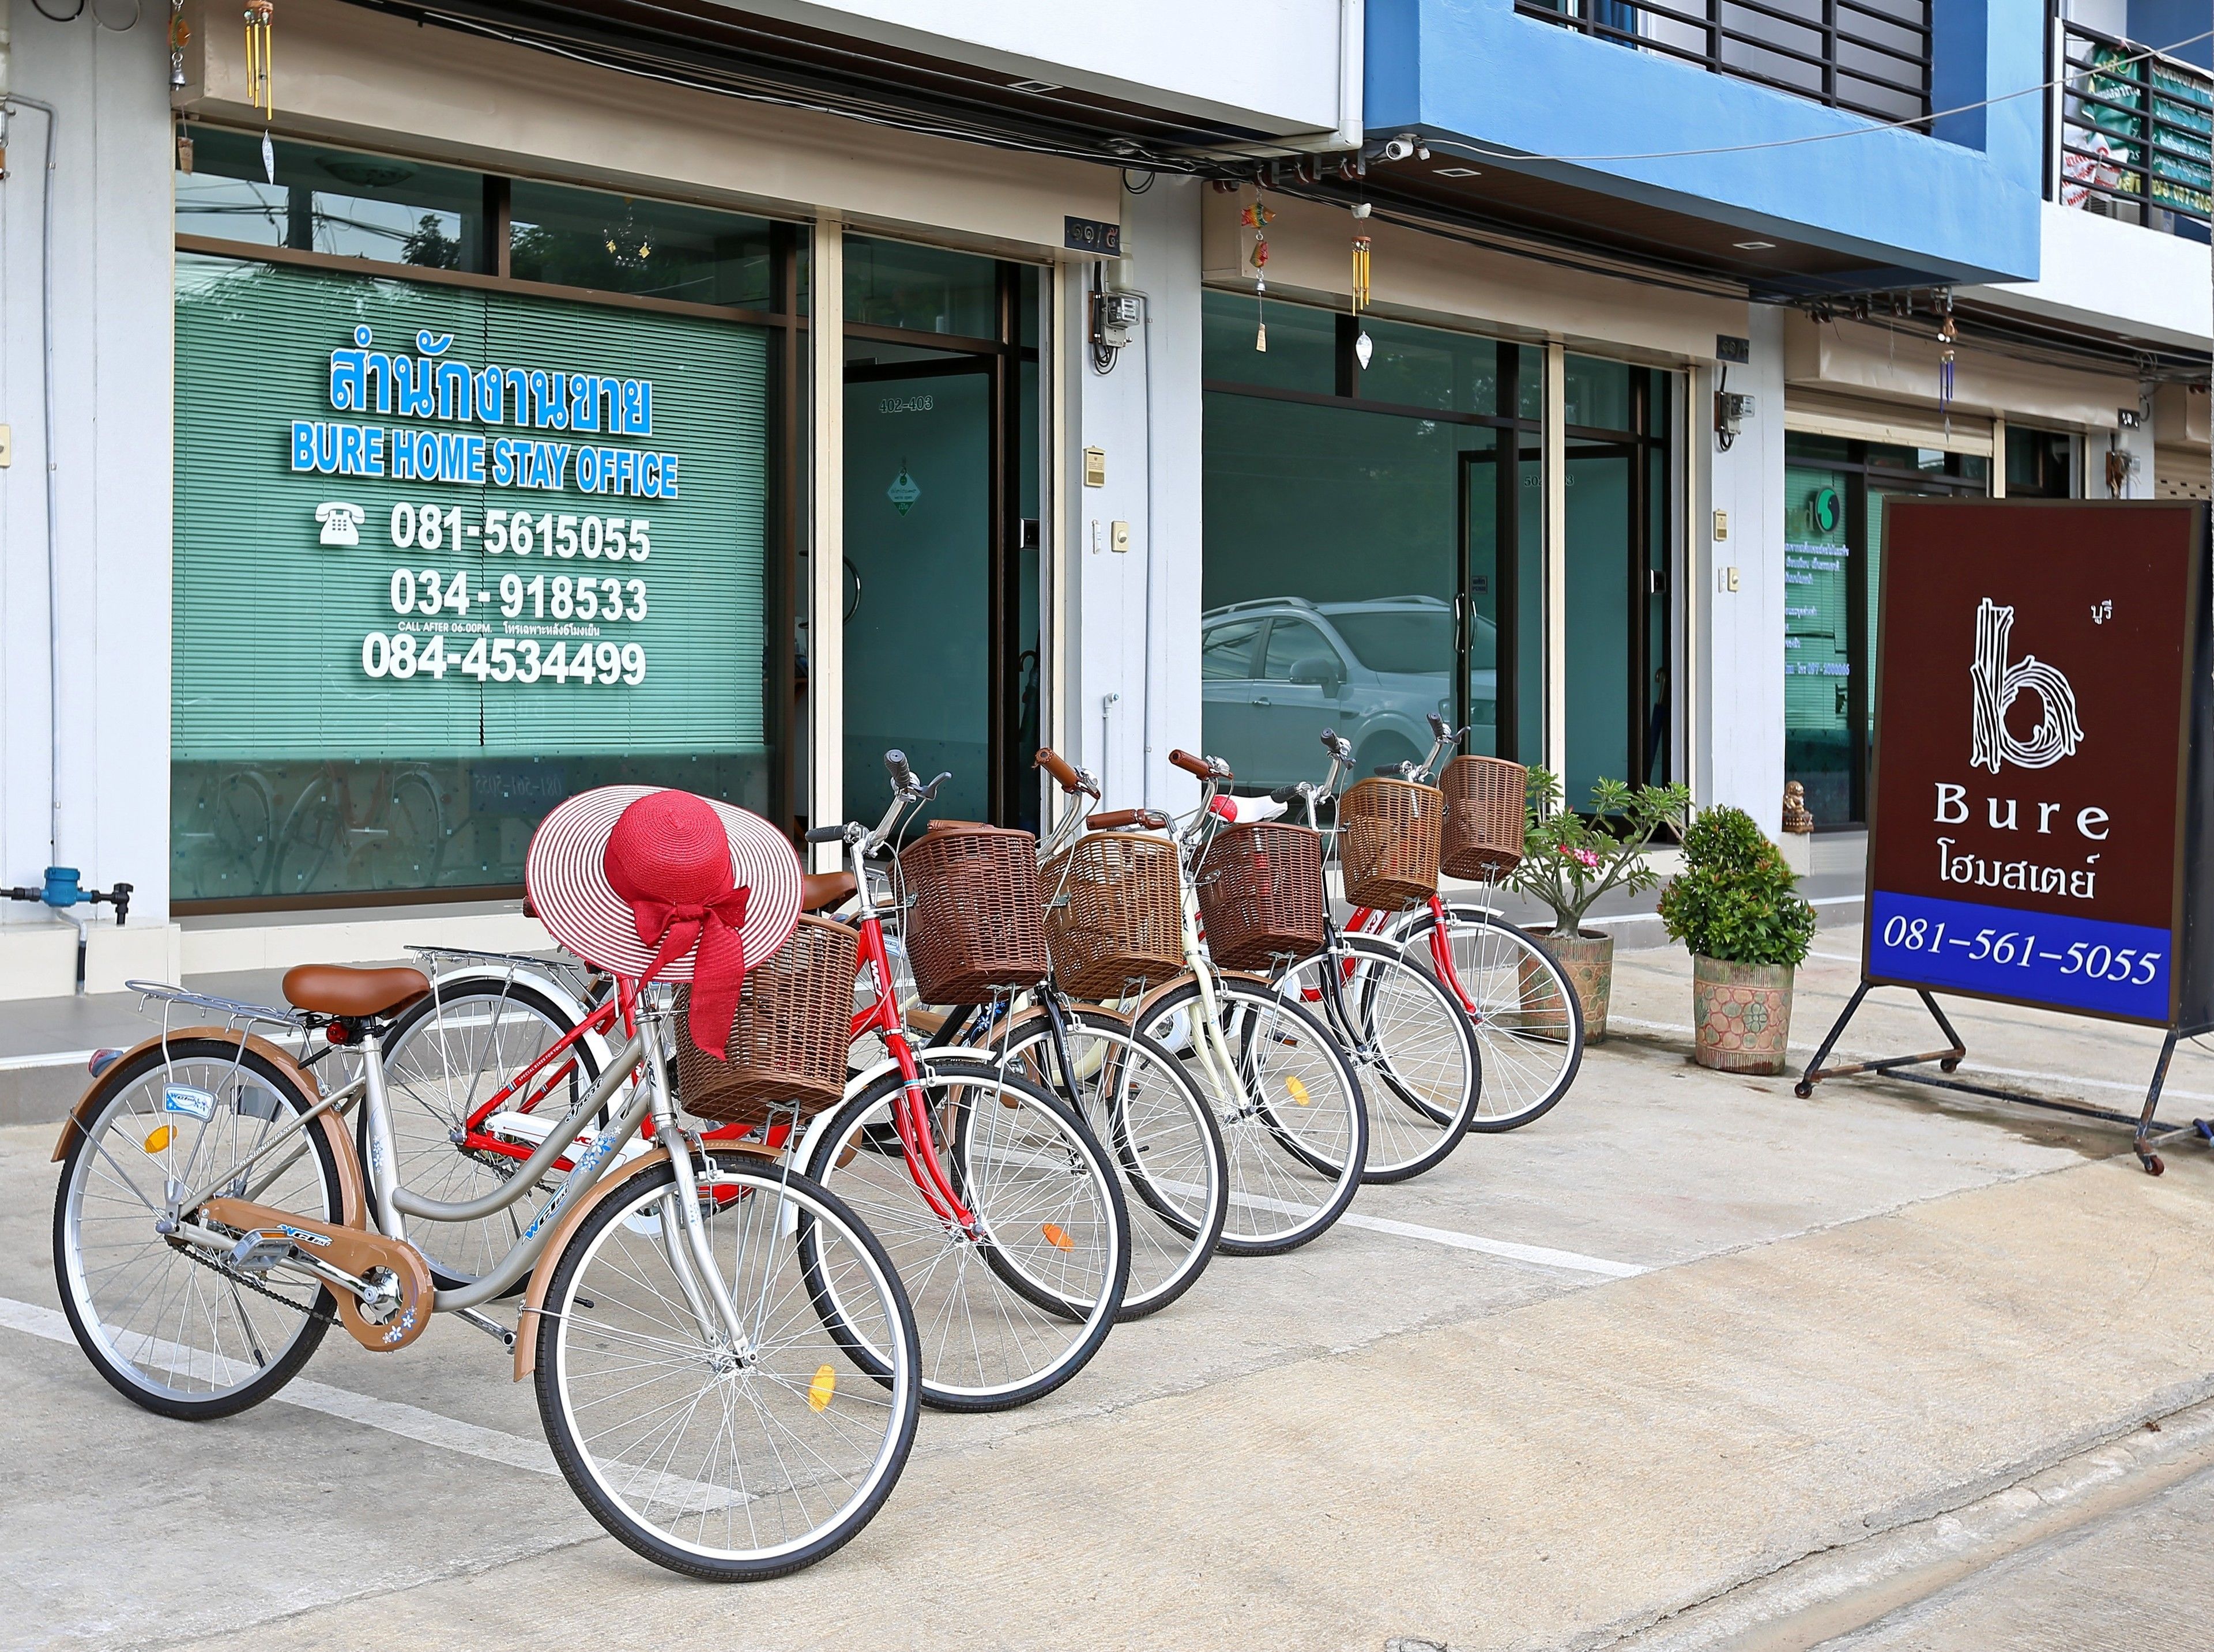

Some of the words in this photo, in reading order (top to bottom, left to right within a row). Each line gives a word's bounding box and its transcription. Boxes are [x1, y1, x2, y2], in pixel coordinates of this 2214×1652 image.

[330, 325, 653, 436] สำนักงานขาย
[879, 395, 933, 413] 402-403
[292, 420, 384, 477] BURE
[391, 429, 486, 484] HOME
[492, 437, 571, 490] STAY
[575, 445, 679, 500] OFFICE
[390, 502, 650, 562] 081-5615055
[398, 621, 420, 632] CALL
[423, 622, 449, 632] AFTER
[362, 632, 646, 685] 084-4534499
[1934, 782, 2110, 840] Bure
[1937, 839, 2102, 899] โฮมสเตย์
[1883, 915, 2162, 986] 081-561-5055
[556, 1188, 569, 1205] BIKE
